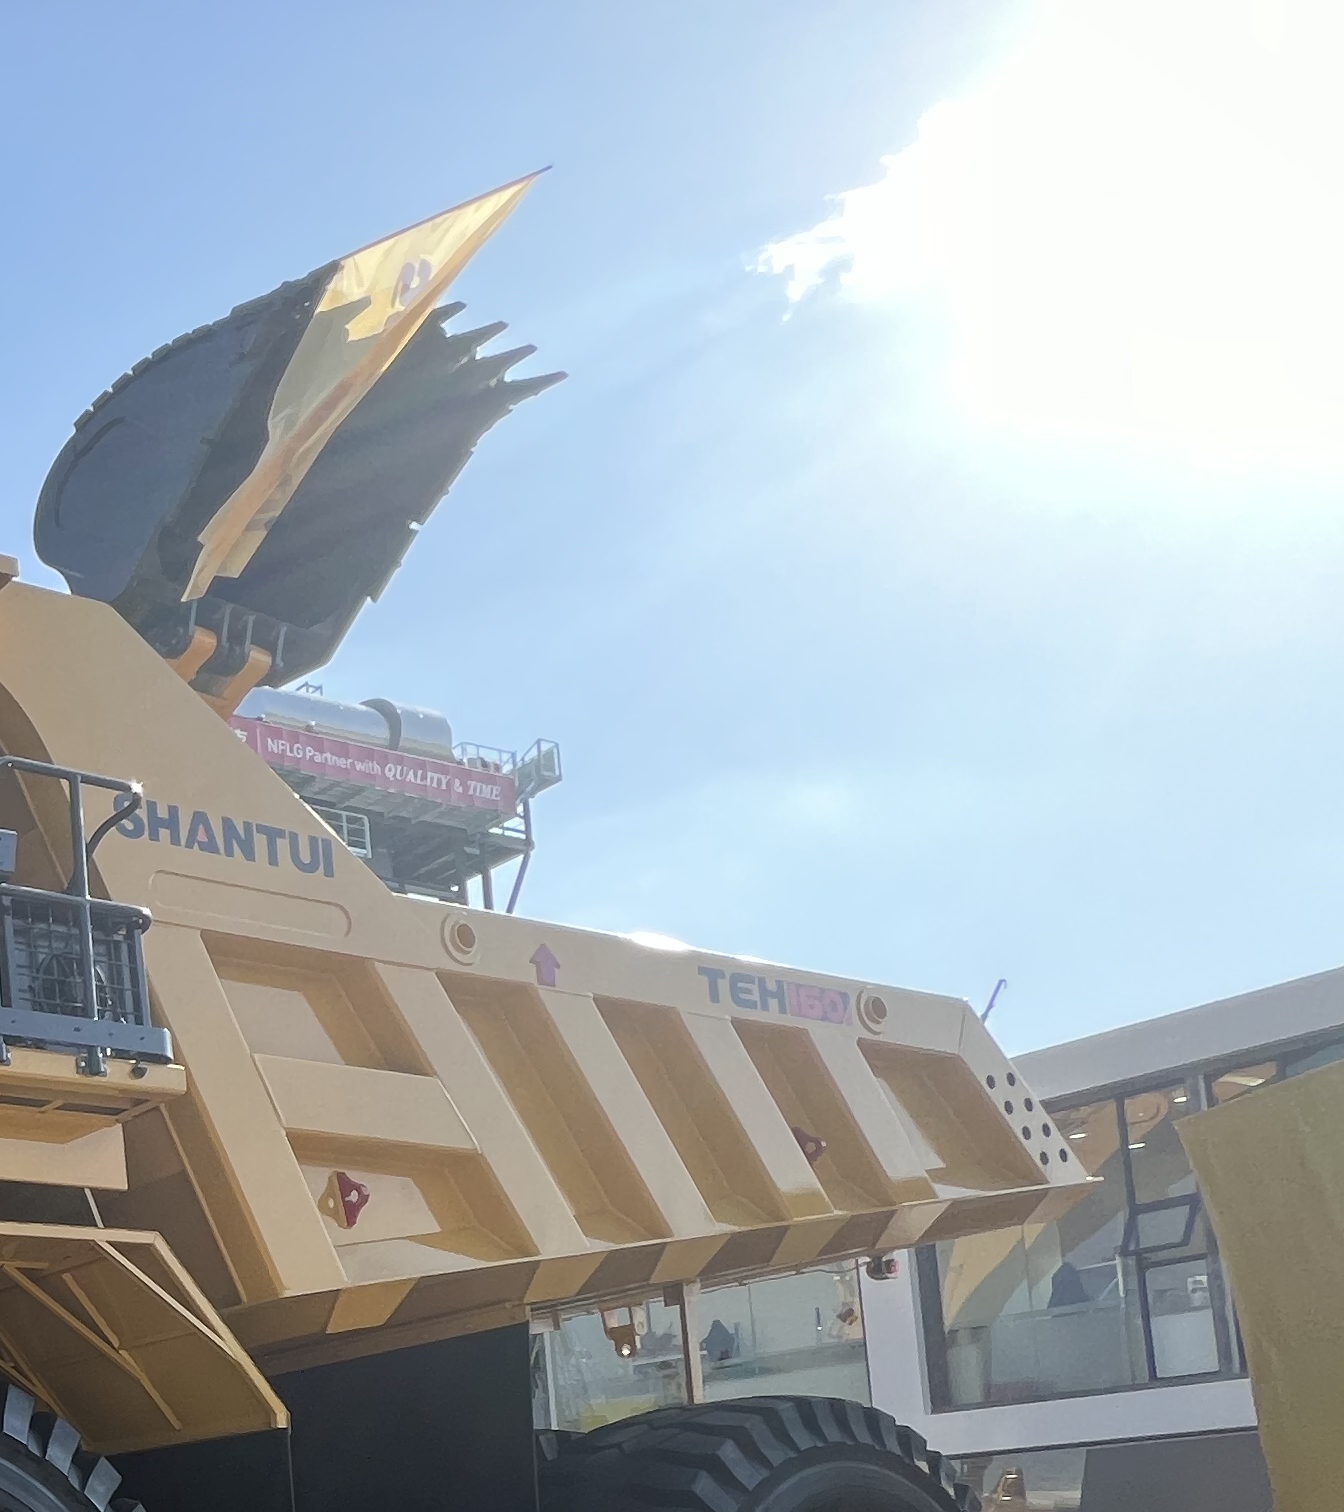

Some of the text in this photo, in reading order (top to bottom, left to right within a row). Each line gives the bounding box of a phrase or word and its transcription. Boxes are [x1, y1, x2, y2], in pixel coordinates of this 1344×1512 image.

[267, 737, 304, 758] NFLG
[305, 746, 353, 770] Partner
[354, 758, 382, 777] with
[383, 763, 450, 791] QUALITY
[453, 778, 464, 793] &
[467, 780, 501, 801] TIME
[112, 791, 335, 878] SHANTUI
